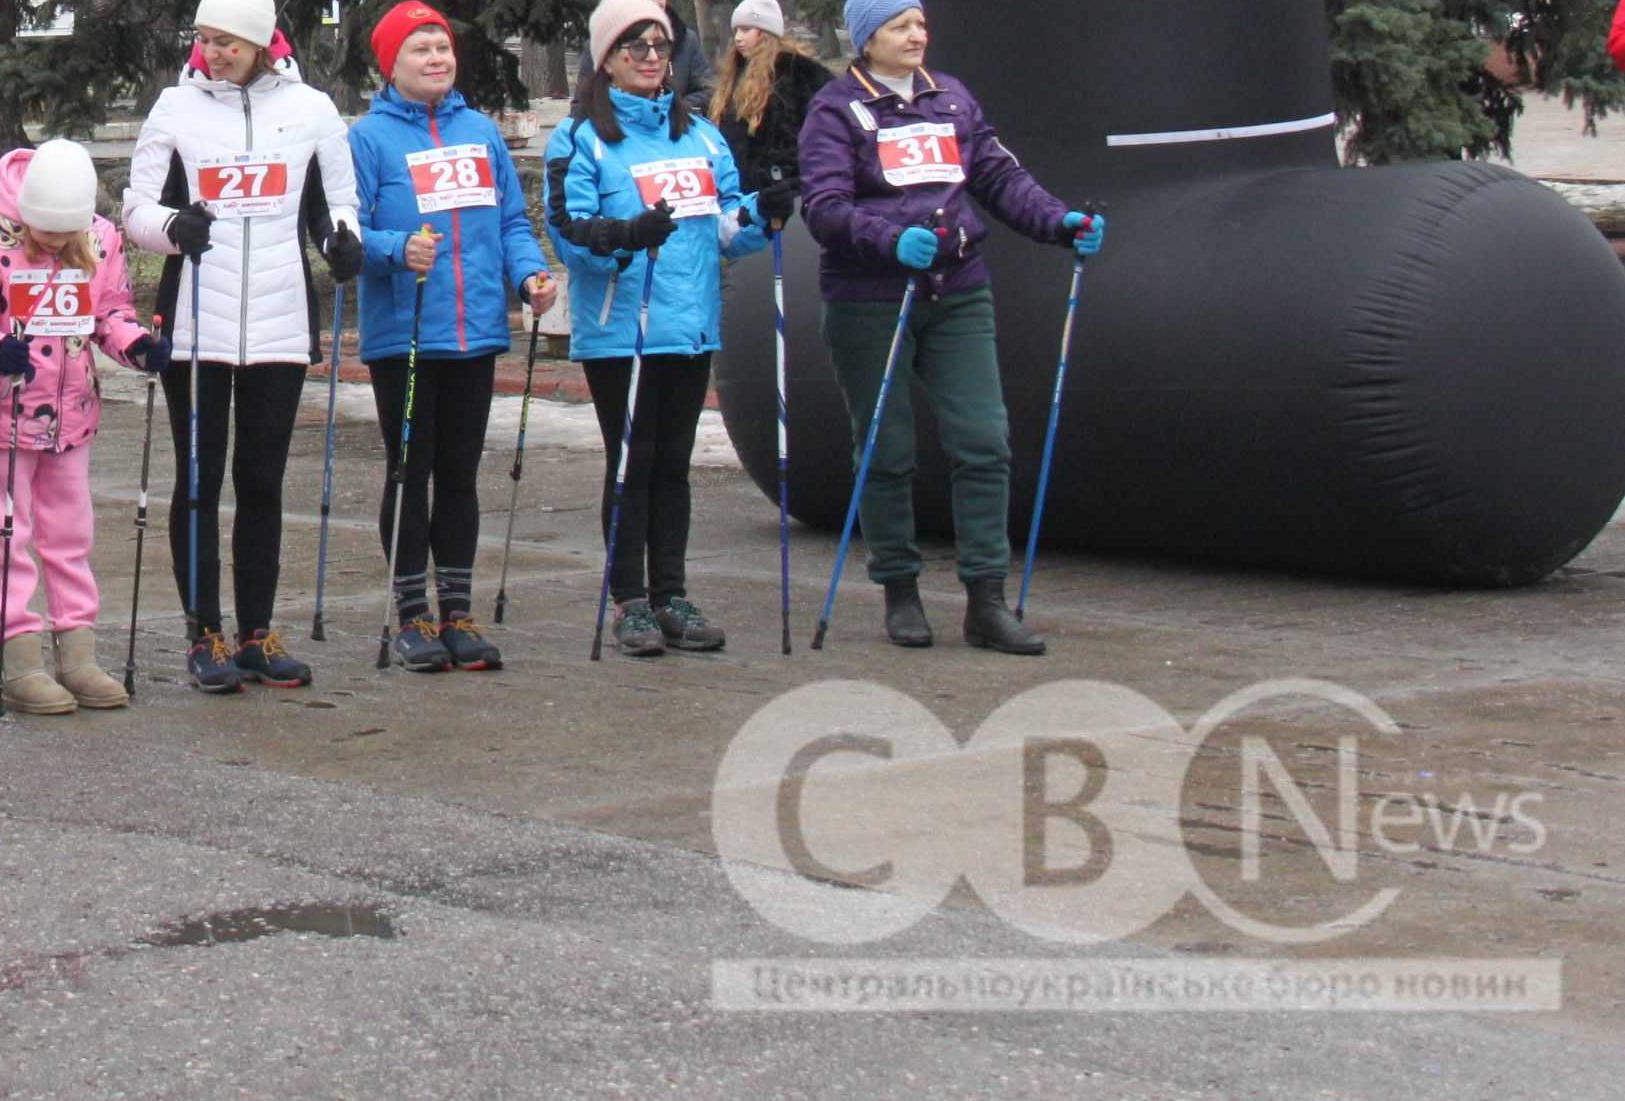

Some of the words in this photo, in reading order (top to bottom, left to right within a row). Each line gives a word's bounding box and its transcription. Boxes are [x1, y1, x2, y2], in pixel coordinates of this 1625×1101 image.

[896, 135, 944, 166] 31
[218, 165, 268, 199] 27
[430, 158, 480, 191] 28
[654, 169, 702, 200] 29
[28, 284, 80, 315] 26
